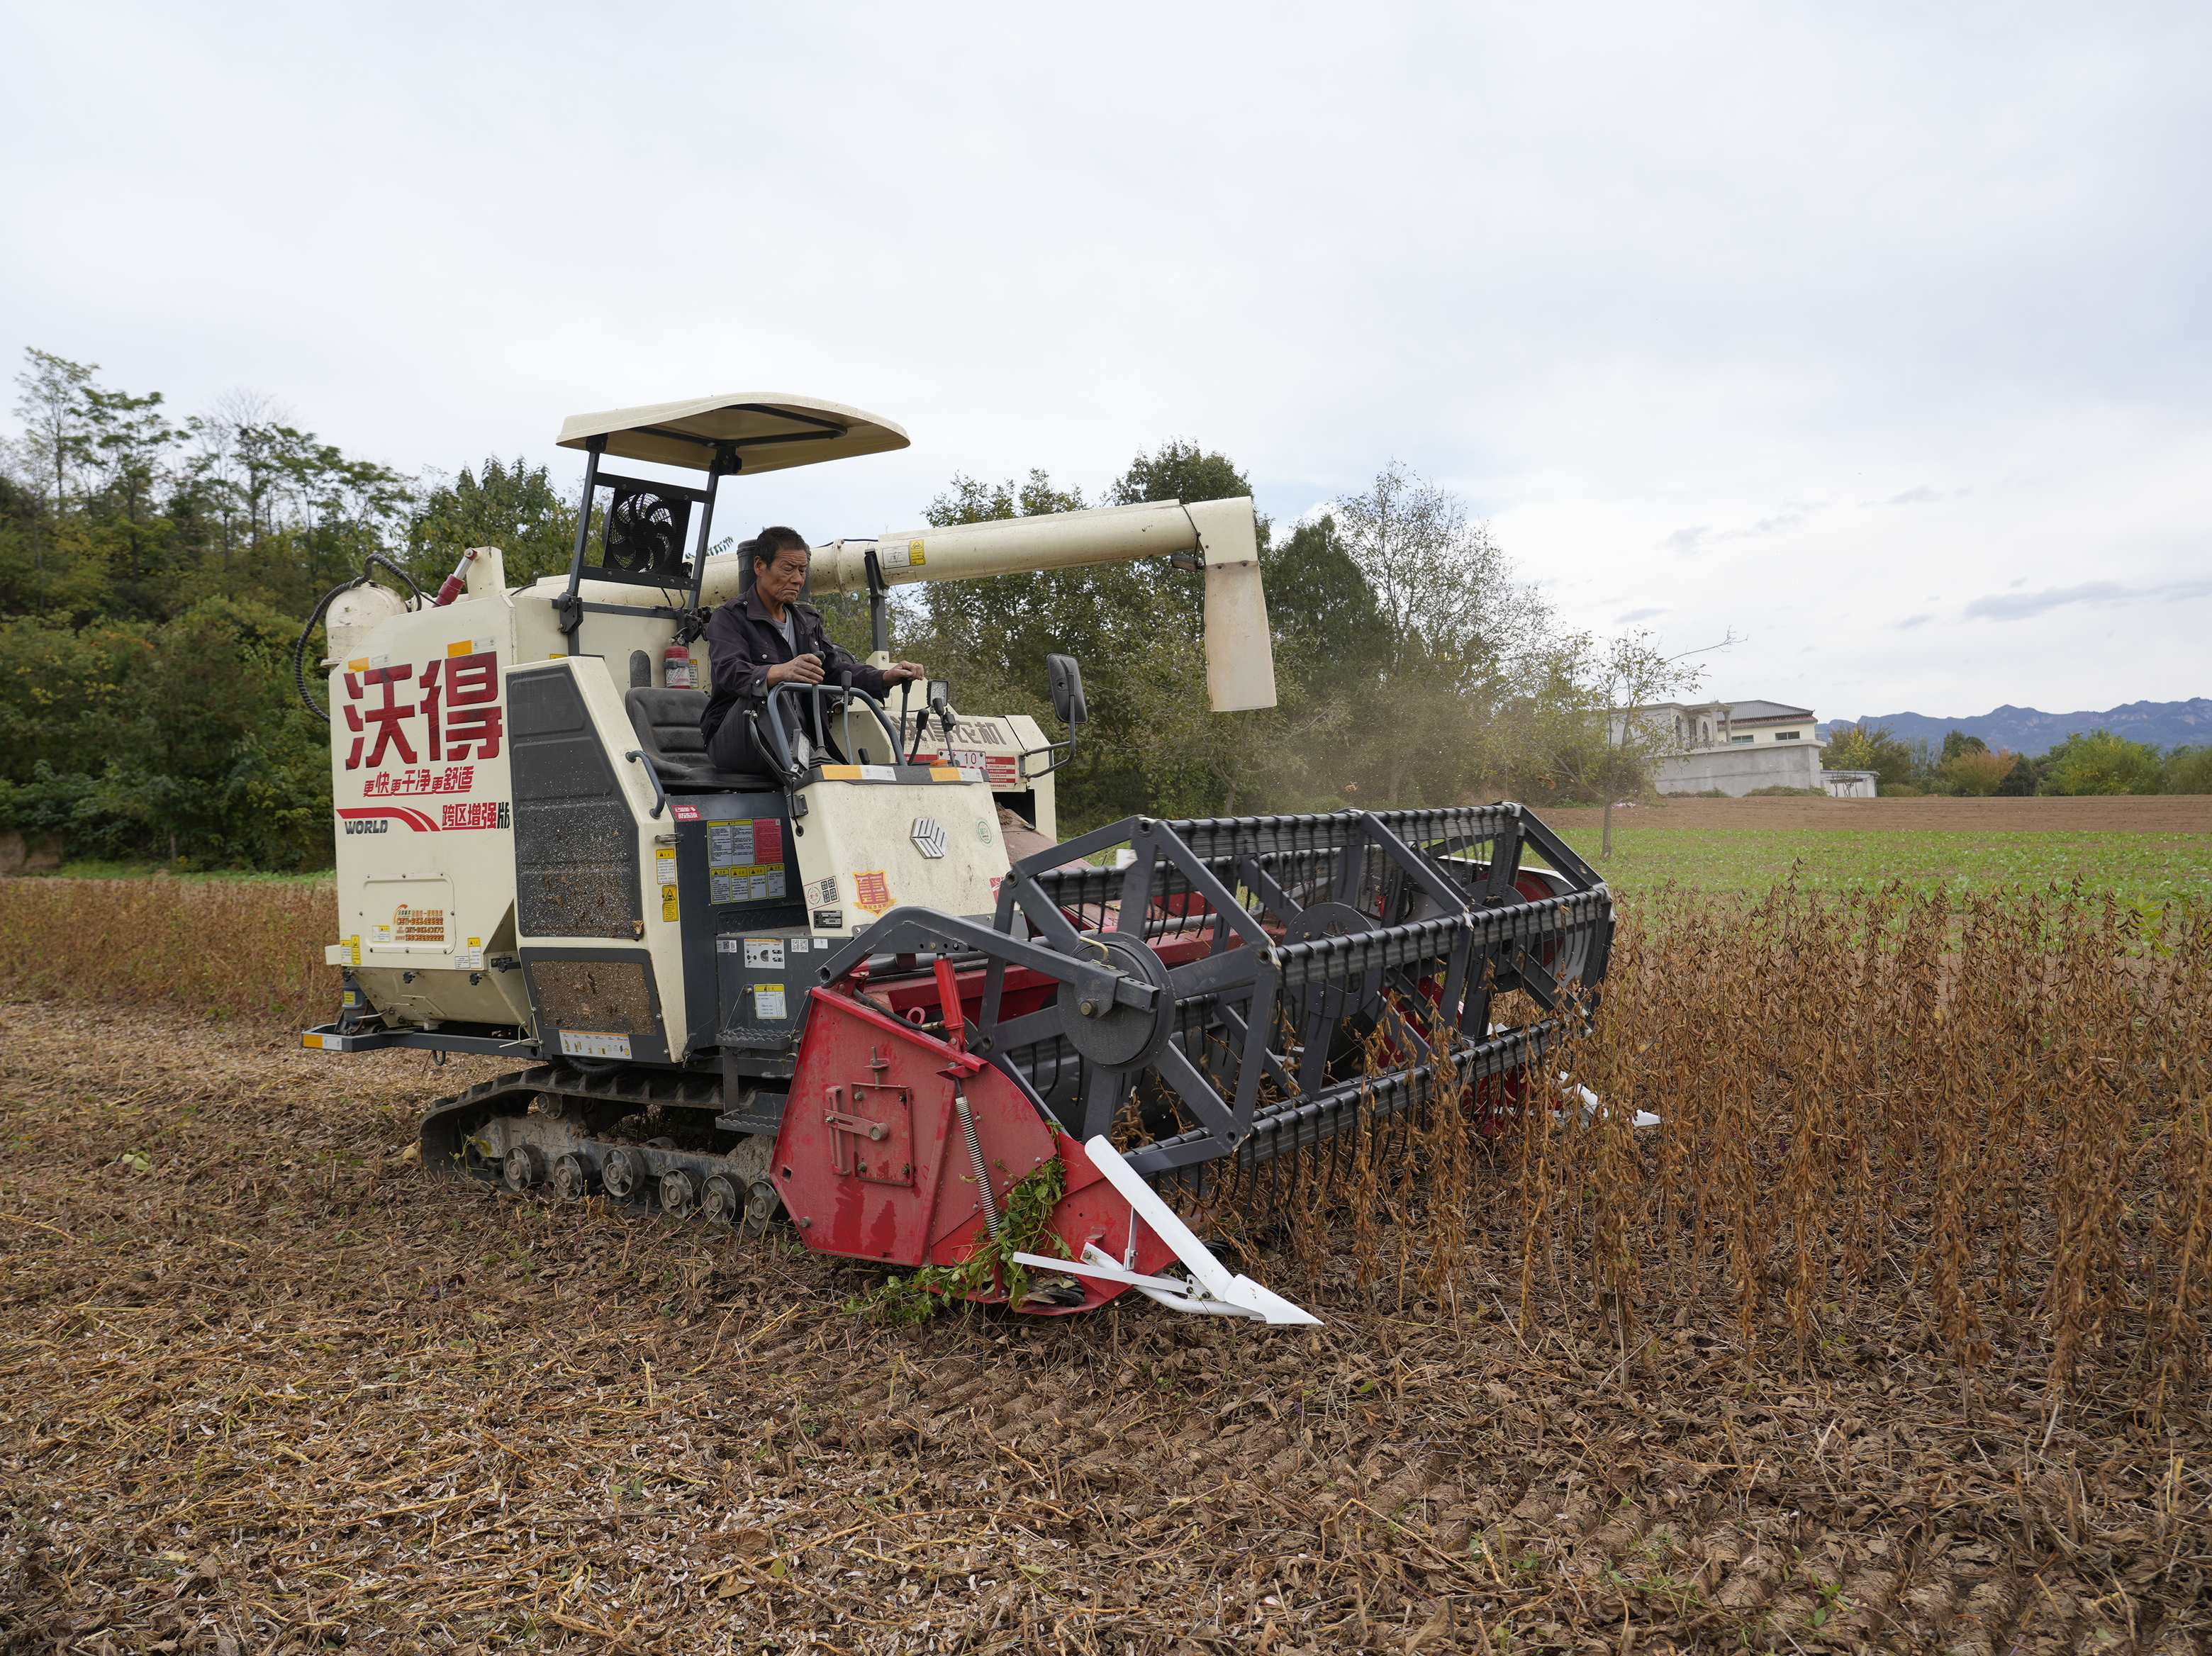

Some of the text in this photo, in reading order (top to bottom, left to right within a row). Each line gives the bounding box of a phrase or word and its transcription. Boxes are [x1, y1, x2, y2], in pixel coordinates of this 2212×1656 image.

[343, 651, 503, 771] 沃得
[363, 766, 474, 798] 更快更干净更舒适
[345, 819, 388, 834] WORLD
[442, 802, 510, 830] 跨区增强版
